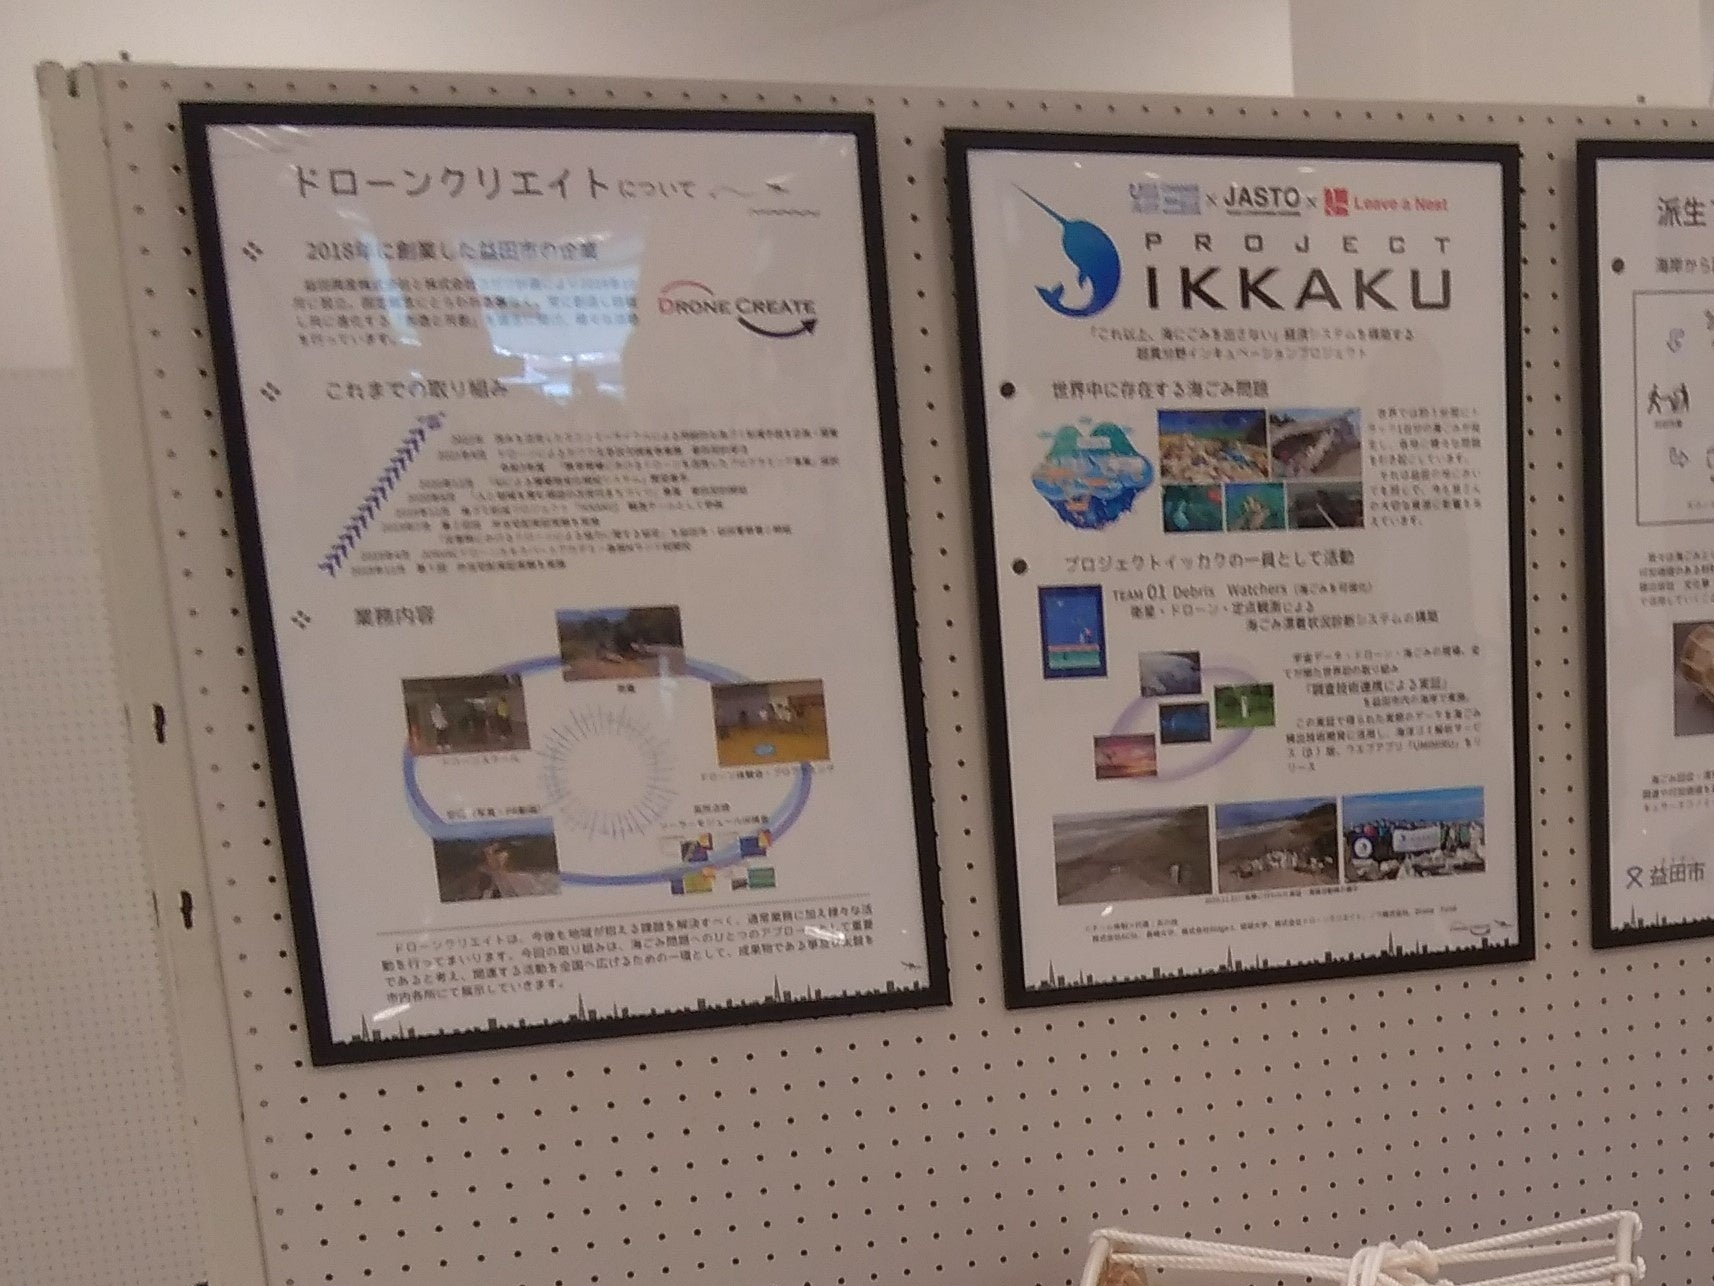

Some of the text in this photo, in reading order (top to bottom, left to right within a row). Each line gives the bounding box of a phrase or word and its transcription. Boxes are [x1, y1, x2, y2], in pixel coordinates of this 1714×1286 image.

[1224, 184, 1301, 208] JASTO
[1353, 196, 1398, 213] Leave
[1413, 197, 1448, 212] Nest
[1144, 231, 1451, 254] PROJECT
[1146, 265, 1452, 312] IKKAKU
[657, 296, 816, 316] DRONE CREATE
[326, 377, 510, 401] これまでの取り組み
[1052, 378, 1270, 400] 世界中に存在する海ごみ問題
[1065, 549, 1355, 573] プロジェクトイッカクの一員として活動
[354, 604, 435, 627] 業務内容
[1649, 861, 1706, 887] 益田市
